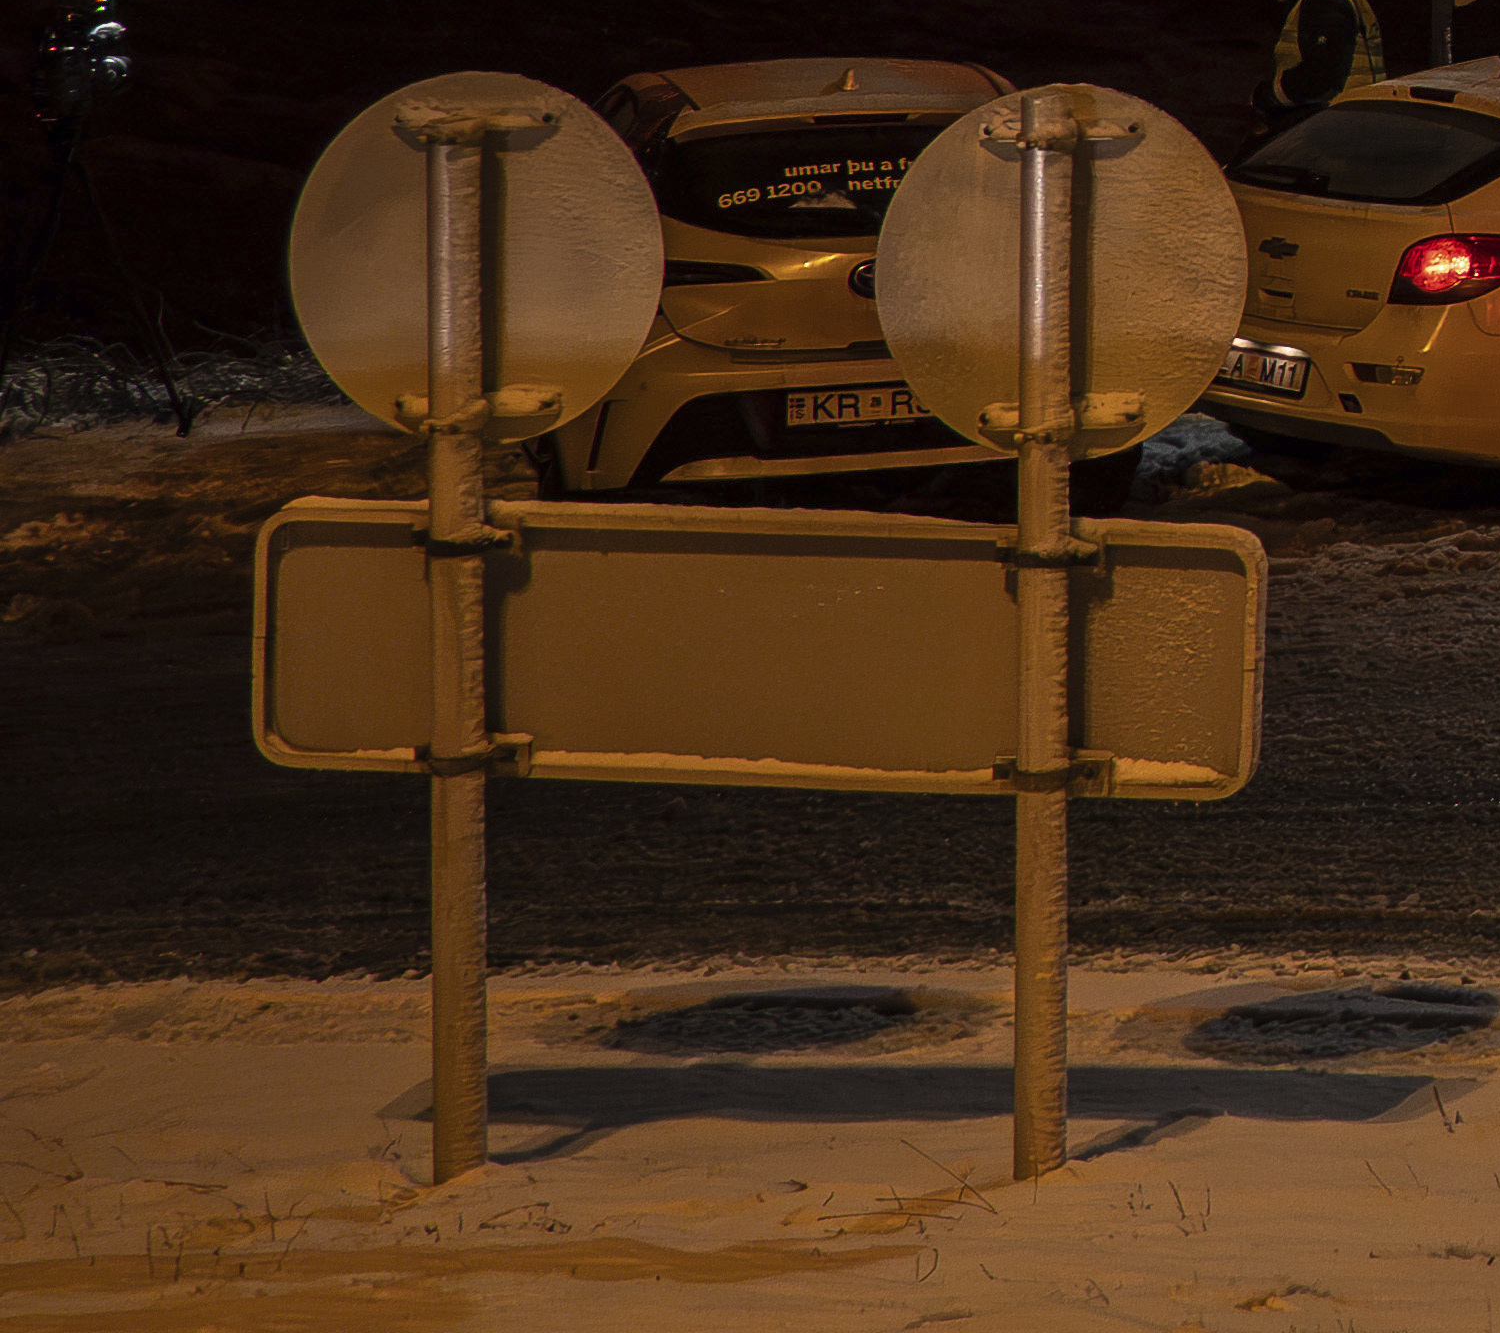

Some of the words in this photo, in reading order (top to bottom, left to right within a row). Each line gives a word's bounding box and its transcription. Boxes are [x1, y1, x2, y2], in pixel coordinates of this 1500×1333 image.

[784, 162, 842, 177] umar
[880, 160, 893, 171] a
[718, 187, 762, 209] 669
[766, 180, 822, 200] 1200
[1259, 357, 1298, 387] M11
[812, 393, 861, 421] KR
